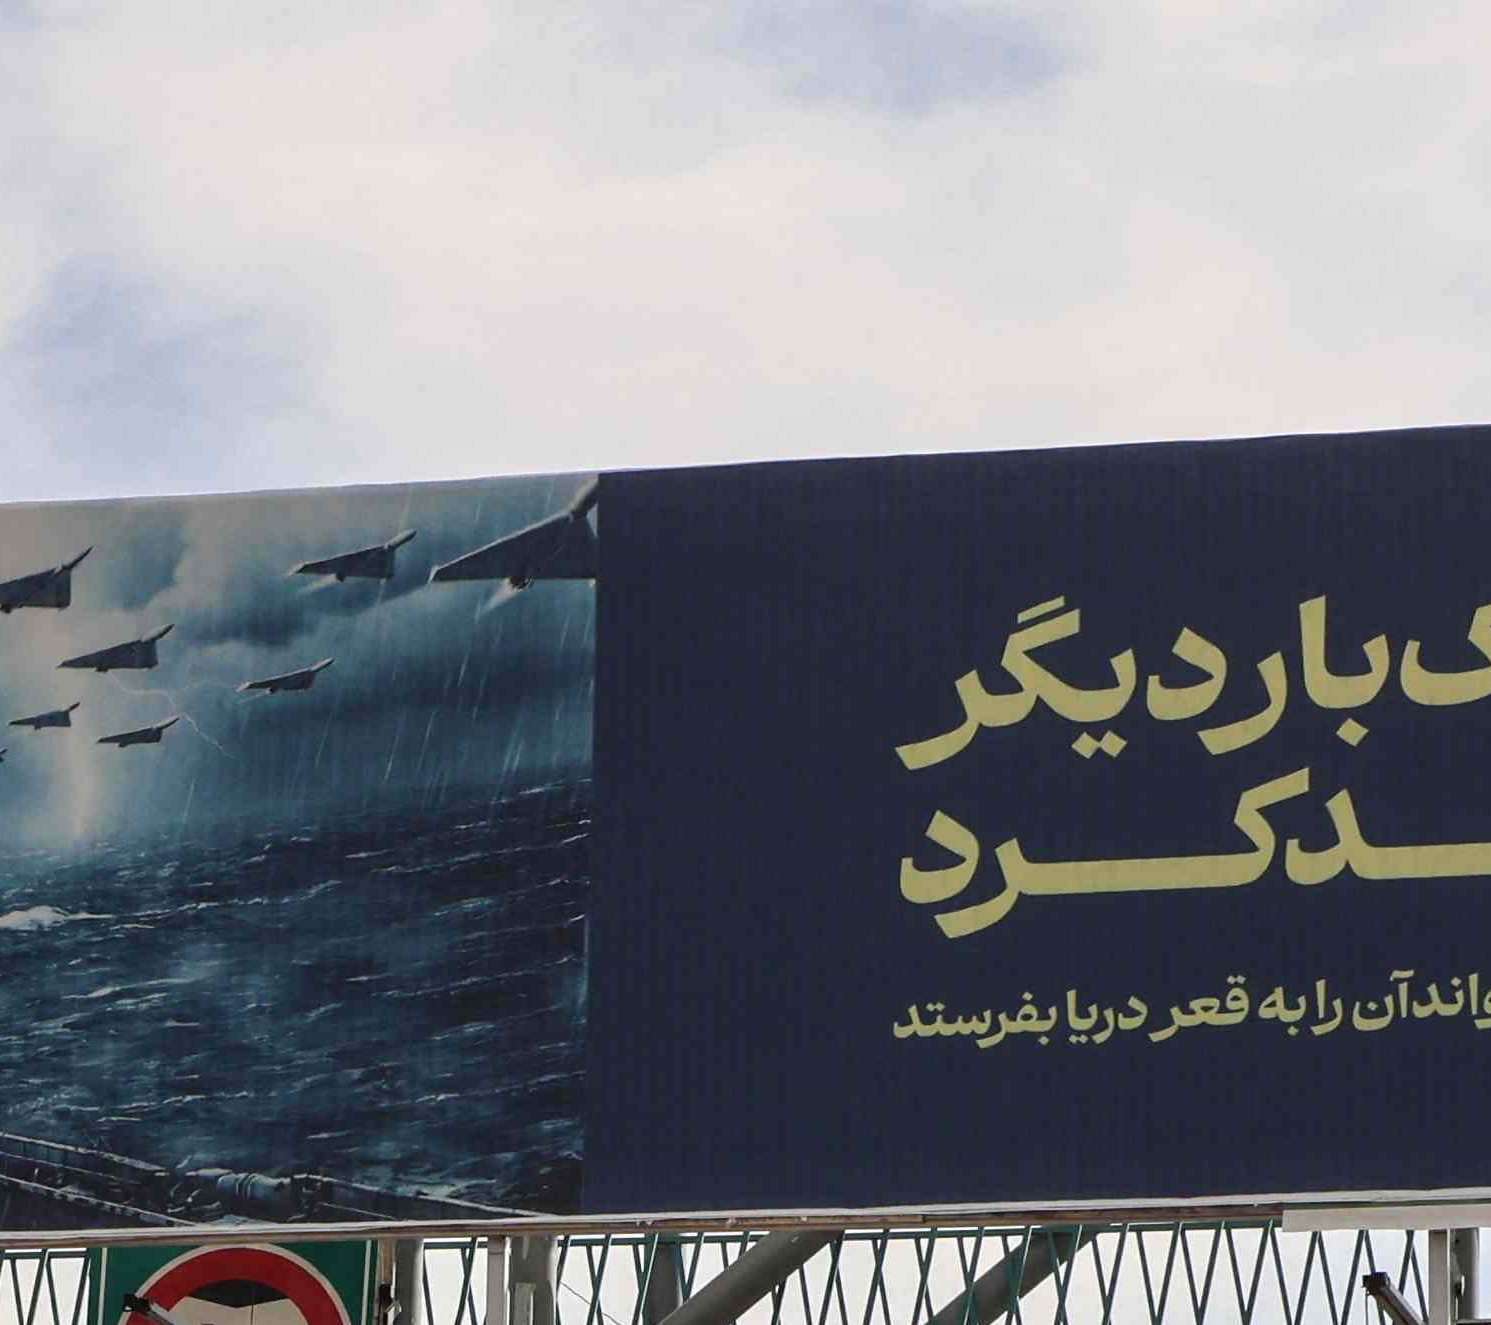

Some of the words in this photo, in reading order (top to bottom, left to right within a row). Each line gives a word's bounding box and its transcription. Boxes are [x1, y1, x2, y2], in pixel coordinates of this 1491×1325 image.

[896, 595, 1228, 770] دیگر
[1195, 594, 1391, 755] بار
[894, 991, 1058, 1049] بفرستد
[1067, 990, 1148, 1043] دریا
[1152, 986, 1251, 1042] قعر
[1257, 986, 1308, 1036] به
[1313, 979, 1345, 1037] را
[1352, 969, 1416, 1033] آن
